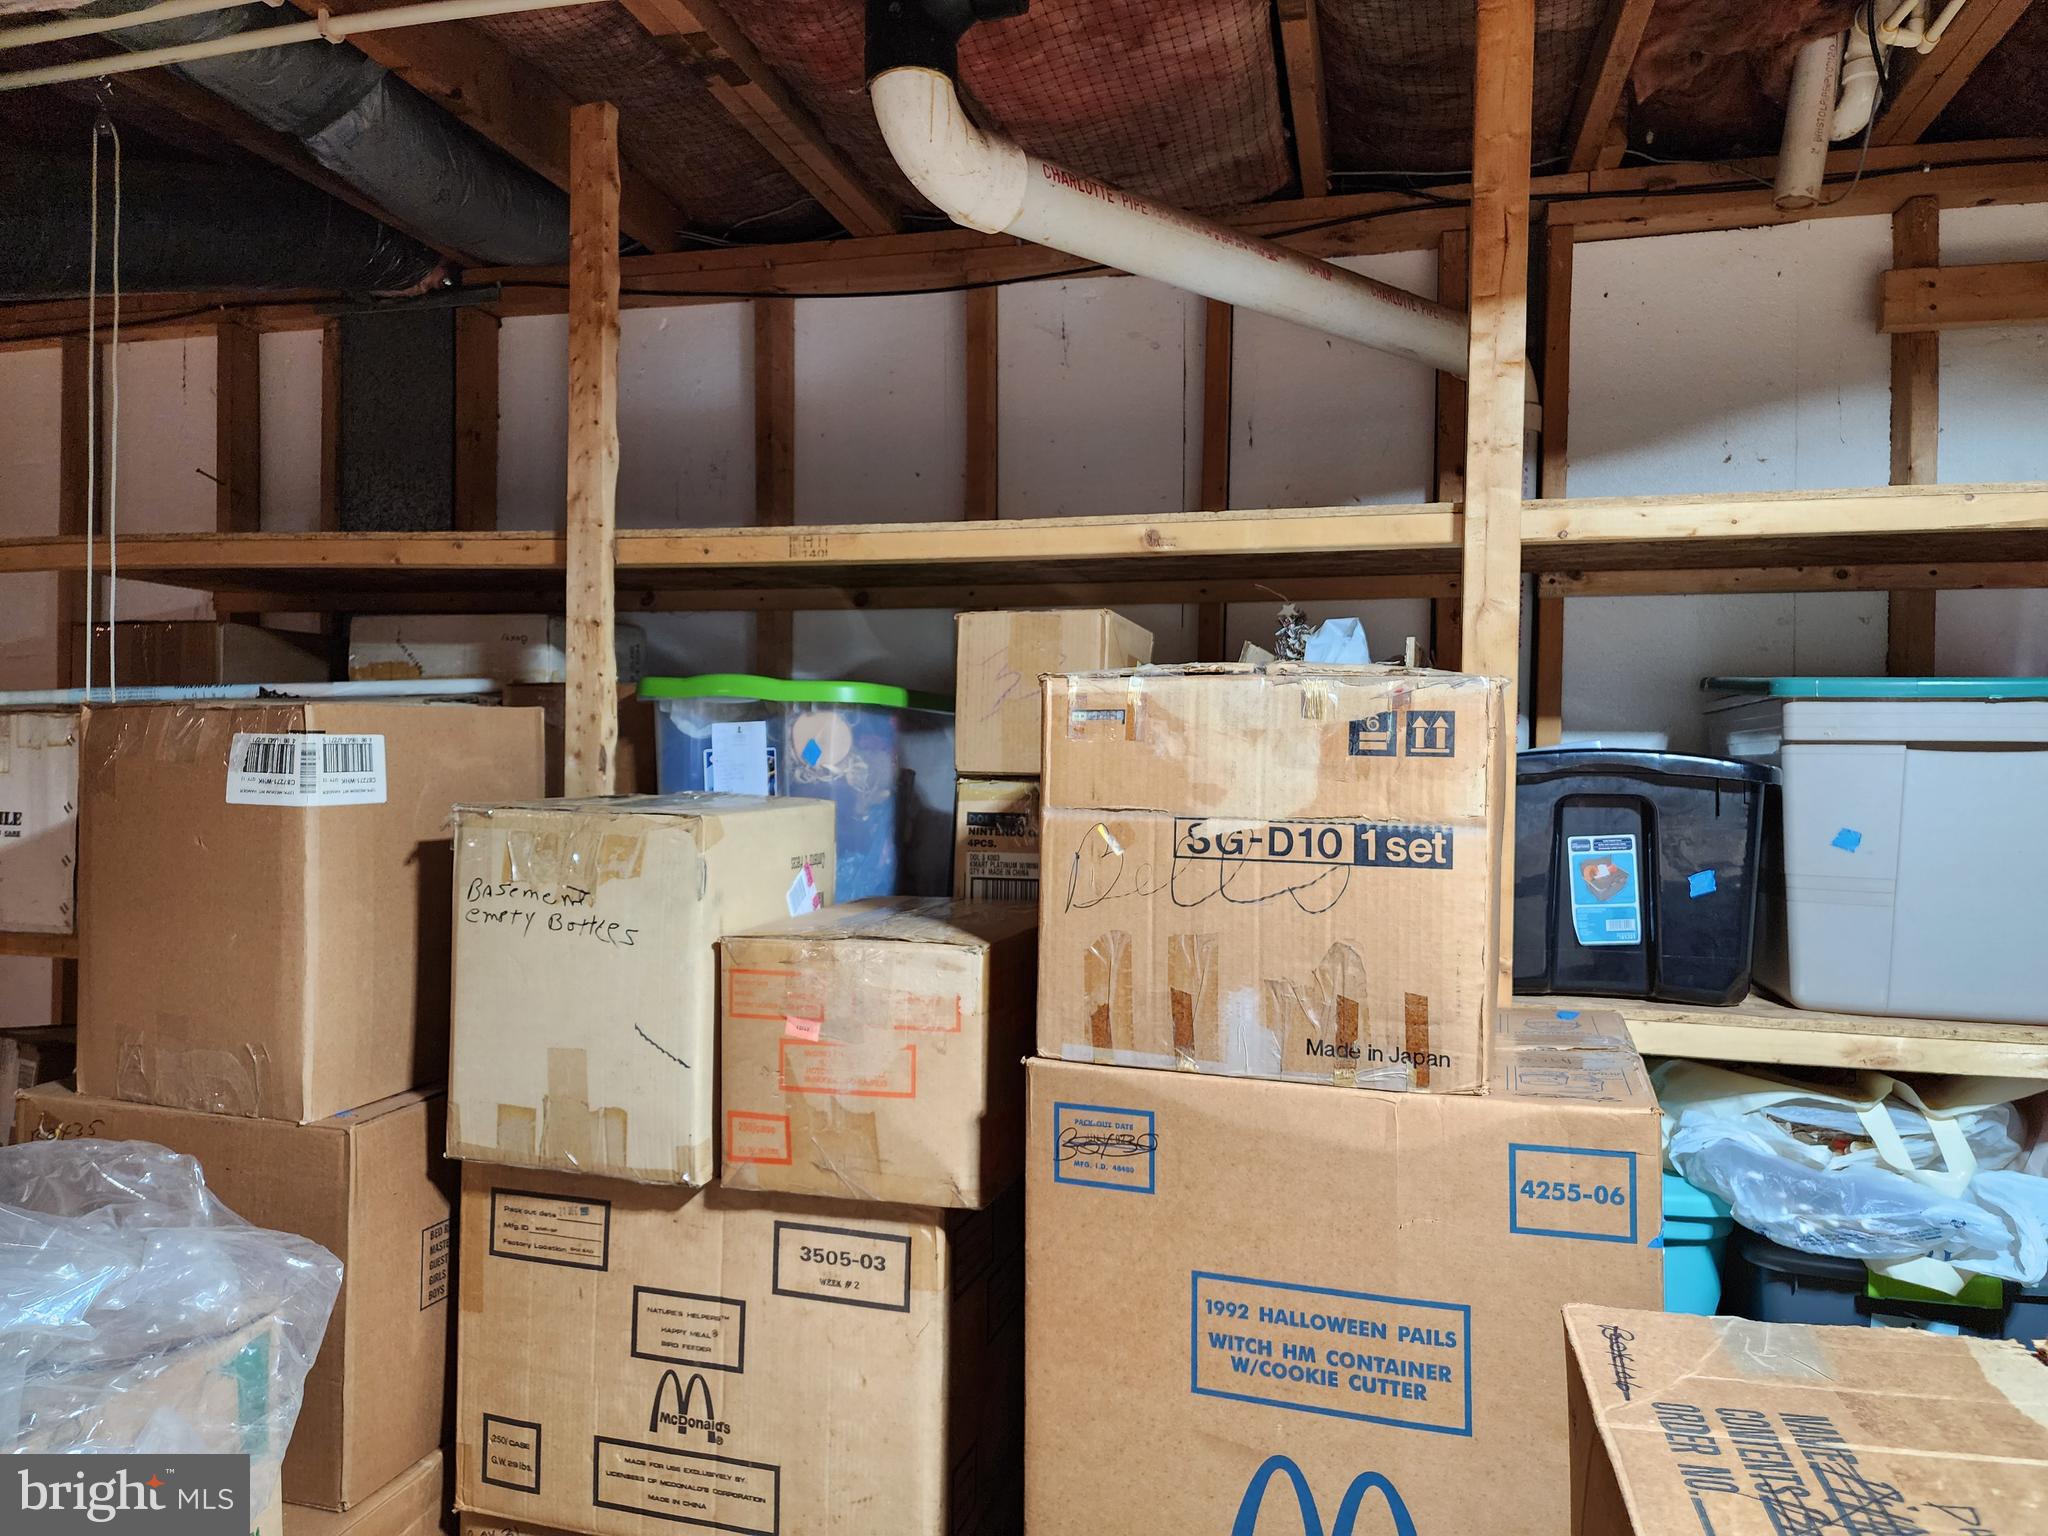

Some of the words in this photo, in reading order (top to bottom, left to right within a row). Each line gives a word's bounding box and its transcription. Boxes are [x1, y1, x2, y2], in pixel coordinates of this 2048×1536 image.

[1042, 163, 1114, 203] CHARLOTTE
[1122, 195, 1149, 215] PIPE
[968, 826, 1025, 838] NINTENDO
[968, 838, 997, 848] 4PCS.
[1360, 828, 1377, 859] 1
[1386, 831, 1447, 865] set
[1306, 1038, 1361, 1059] Made
[1367, 1043, 1383, 1063] in
[1389, 1046, 1451, 1069] Japan
[1115, 1122, 1134, 1131] DATE
[1073, 1160, 1093, 1170] MFG.
[1520, 1180, 1625, 1206] 4255-06
[539, 1210, 557, 1219] date
[503, 1238, 532, 1249] Factory
[534, 1243, 568, 1253] Location
[799, 1245, 887, 1272] 3505-03
[660, 1327, 688, 1336] HAPPY
[1205, 1298, 1250, 1320] 1992
[1259, 1306, 1388, 1340] HALLOWEEN
[1397, 1325, 1458, 1348] PAILS
[682, 1343, 712, 1353] FEEDER
[1207, 1331, 1273, 1357] WITCH
[1282, 1342, 1317, 1364] HM
[1325, 1349, 1453, 1383] CONTAINER
[1230, 1355, 1339, 1388] W/COOKIE
[1348, 1374, 1428, 1402] CUTTER
[659, 1411, 732, 1435] McDonald's
[1652, 1400, 1721, 1457] ORDER
[1715, 1406, 1811, 1500] CONTENTS
[623, 1456, 647, 1467] MADE
[649, 1460, 665, 1470] FOR
[666, 1464, 681, 1473] USE
[683, 1466, 733, 1482] EXCLUSIVELY
[605, 1470, 646, 1483] LICENSEES
[647, 1477, 658, 1486] OF
[712, 1487, 767, 1504] CORPORATION
[647, 1493, 670, 1504] MADE
[672, 1498, 681, 1506] IN
[682, 1500, 708, 1510] CHINA
